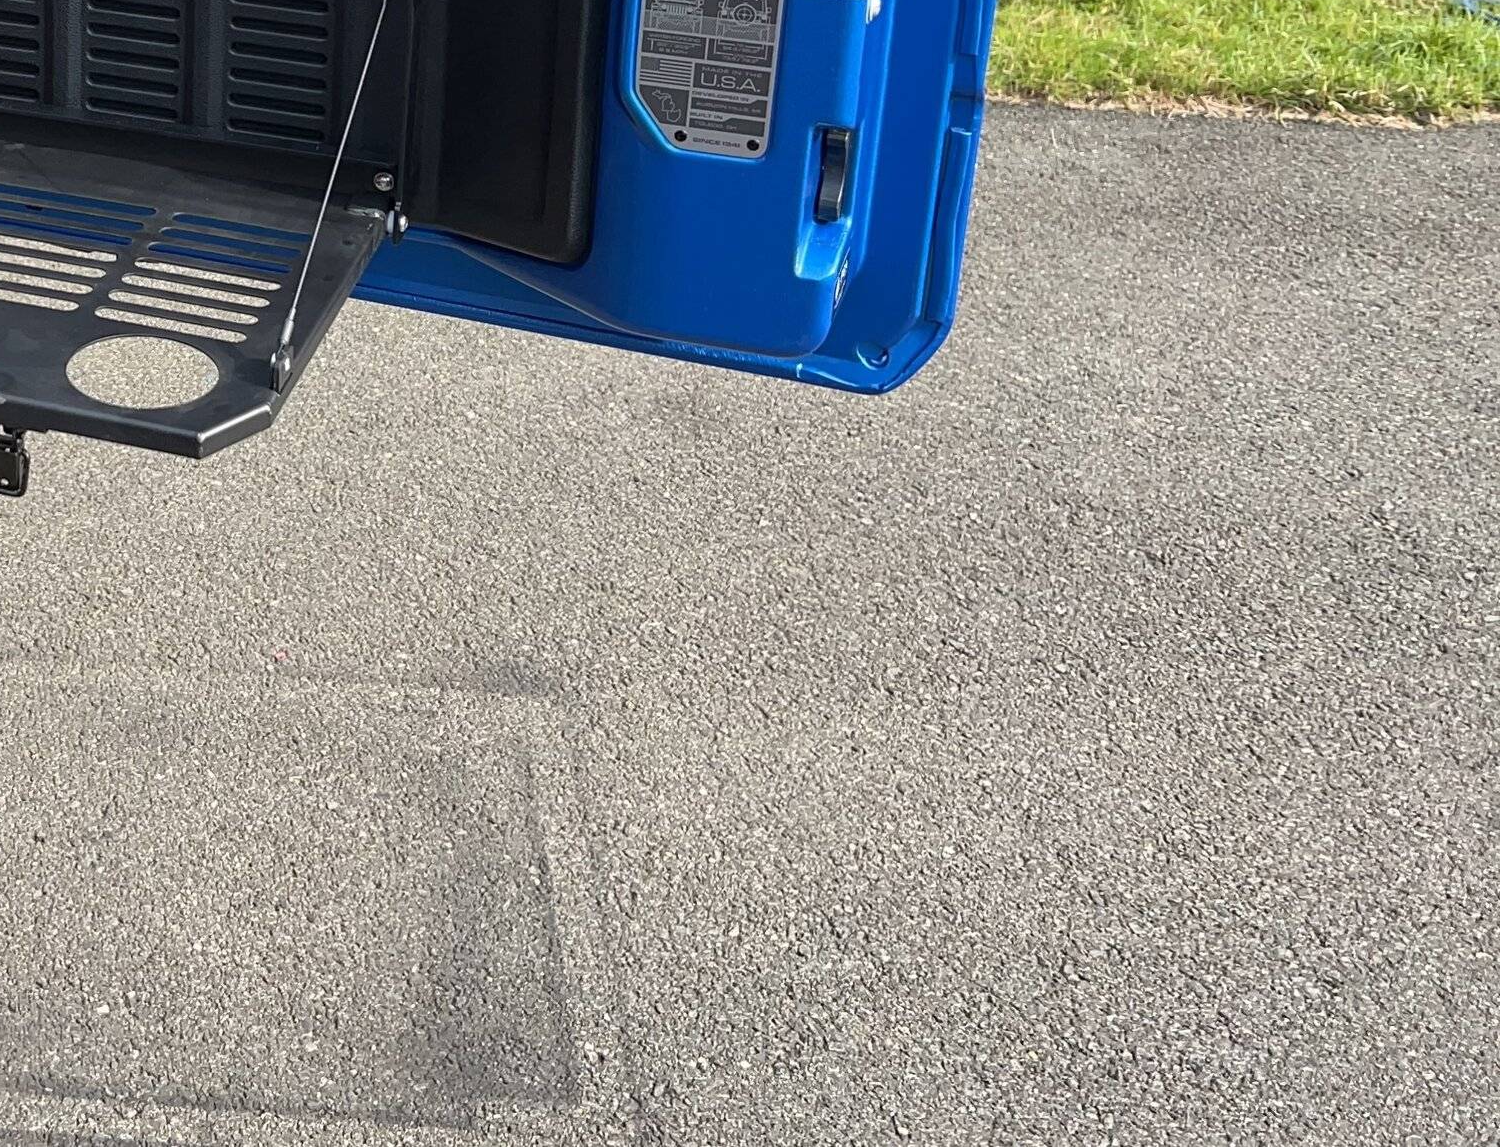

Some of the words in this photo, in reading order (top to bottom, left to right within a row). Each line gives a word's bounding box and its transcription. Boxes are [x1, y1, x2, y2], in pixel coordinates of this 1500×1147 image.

[701, 66, 728, 74] MADE
[701, 72, 761, 93] U.S.A.
[693, 137, 721, 146] SINCE
